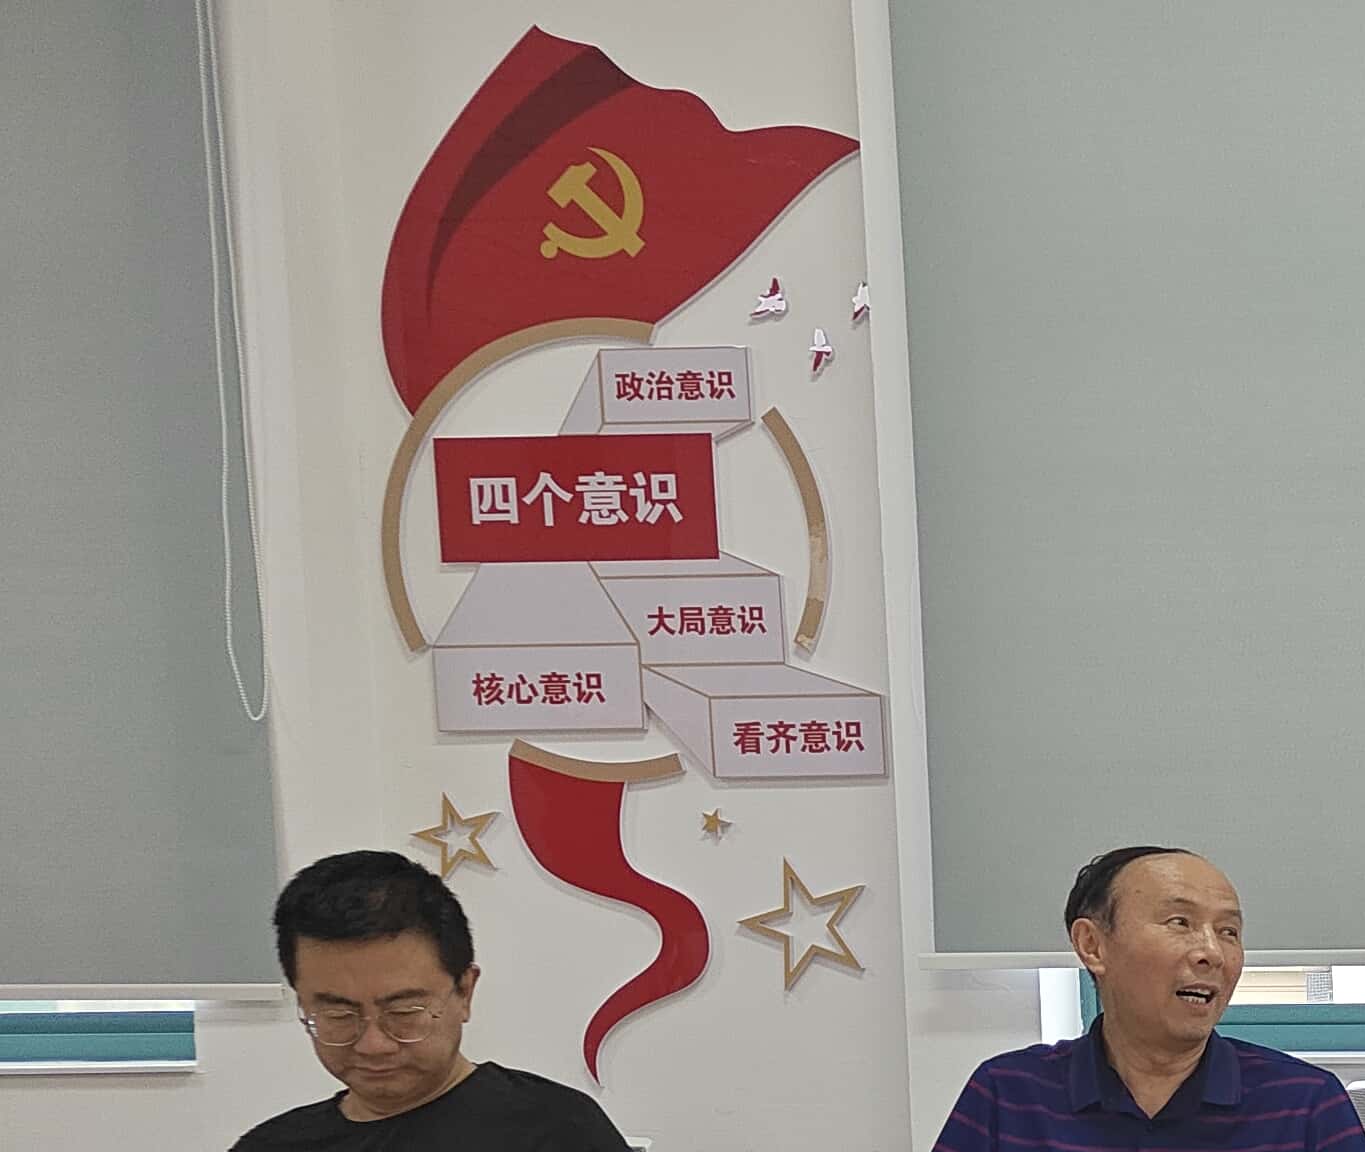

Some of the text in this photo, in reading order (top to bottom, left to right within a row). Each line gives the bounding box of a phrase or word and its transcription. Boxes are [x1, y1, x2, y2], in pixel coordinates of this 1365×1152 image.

[614, 368, 736, 403] 政治意识
[469, 471, 683, 527] 四个意识
[646, 603, 767, 637] 大局意识
[471, 671, 606, 706] 核心意识
[731, 719, 865, 754] 看齐意识
